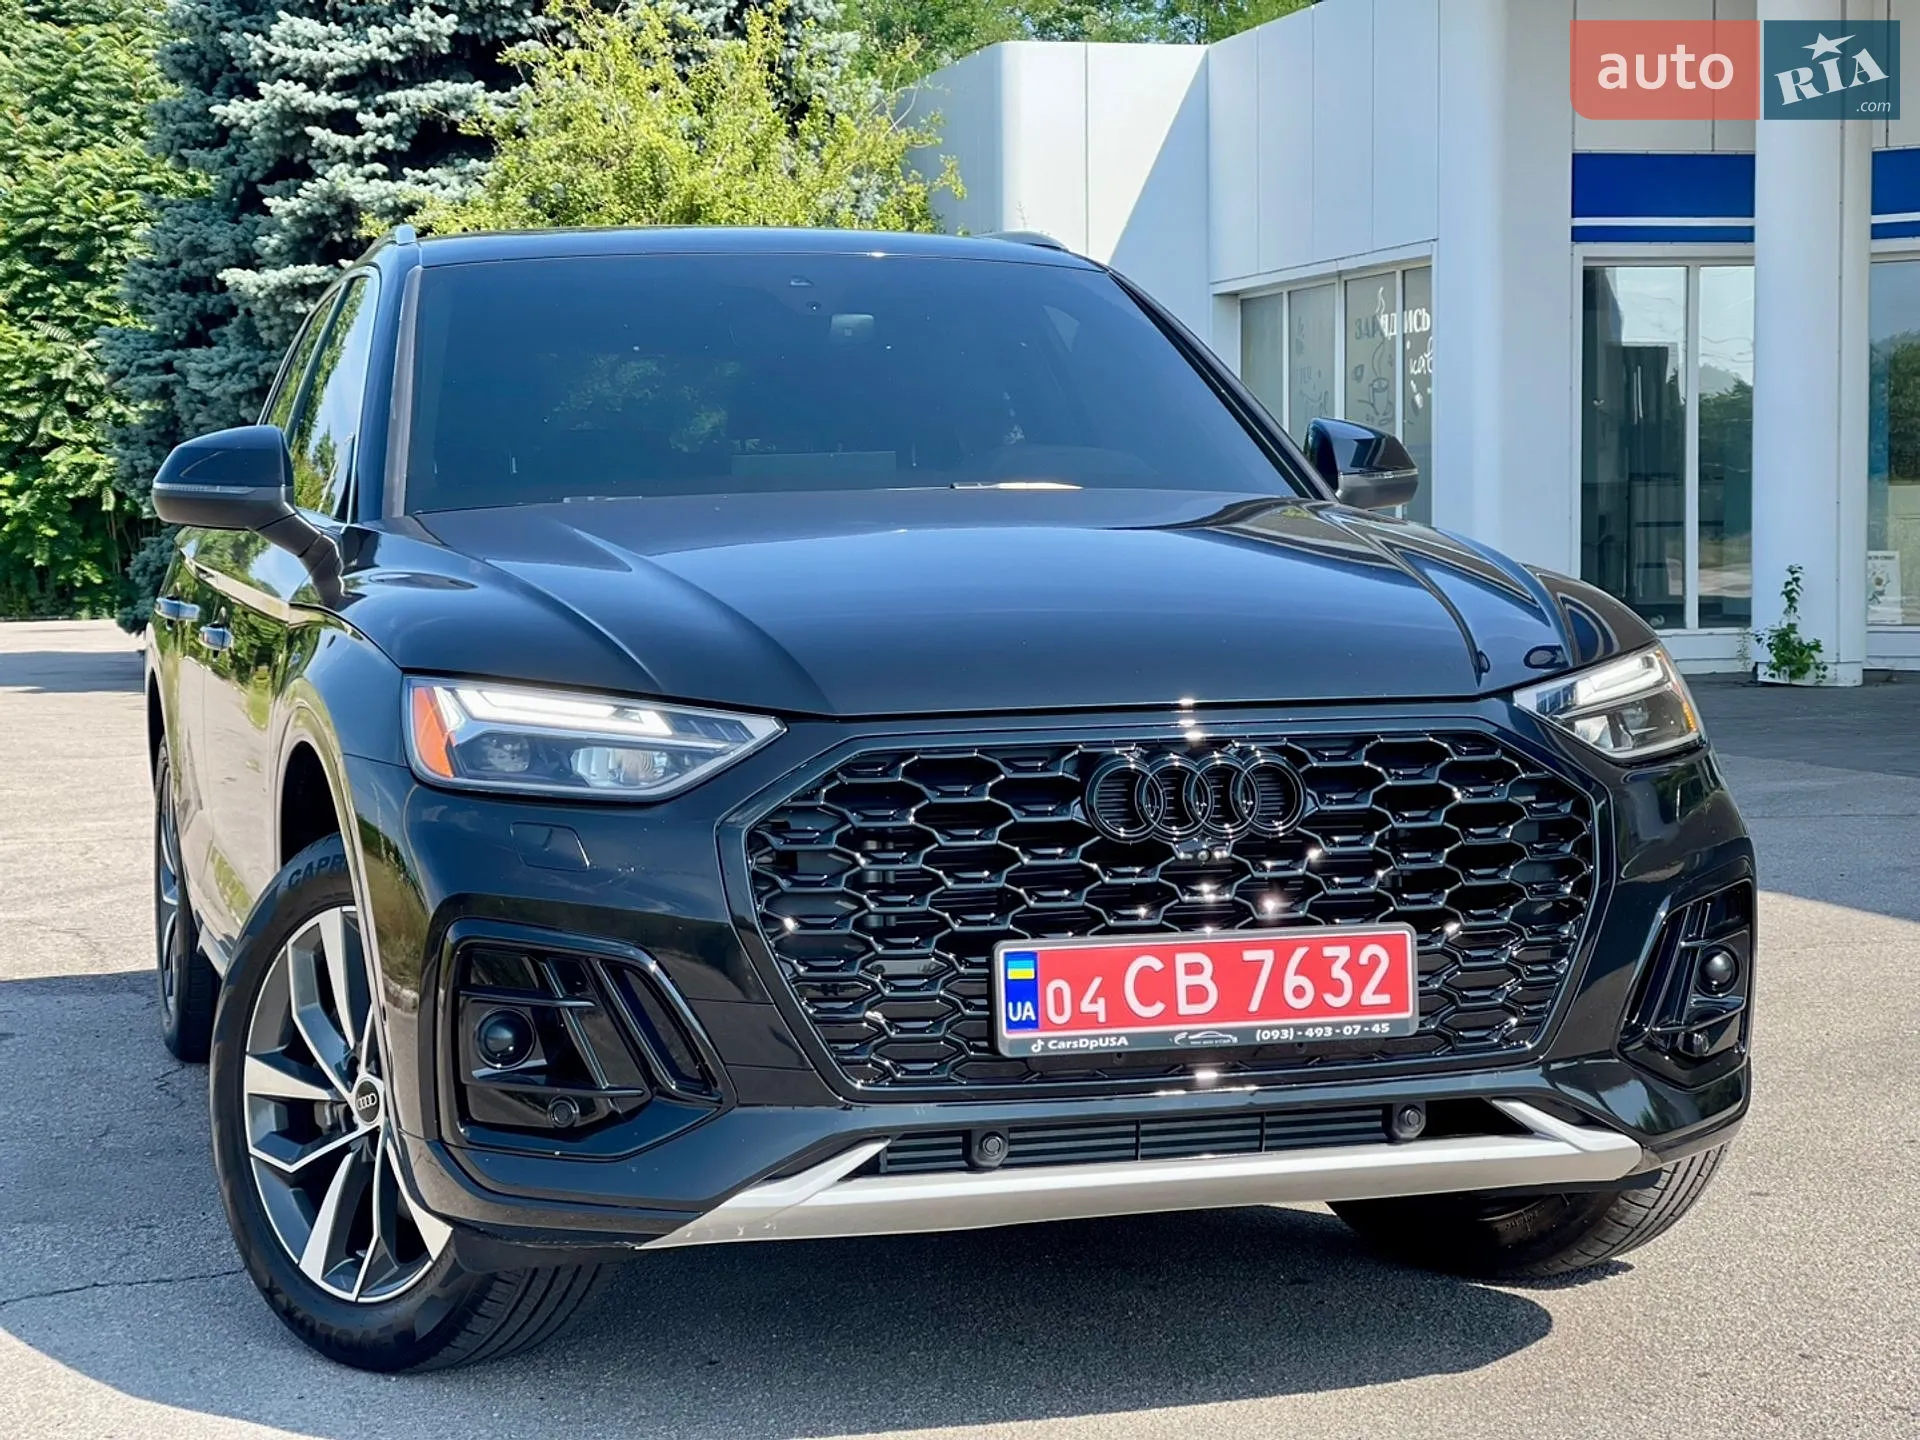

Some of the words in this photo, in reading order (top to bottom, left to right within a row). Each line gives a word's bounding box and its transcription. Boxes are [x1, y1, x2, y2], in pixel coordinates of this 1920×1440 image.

[1045, 976, 1106, 1025] 04
[1123, 952, 1219, 1018] CB
[1241, 943, 1391, 1013] 7632
[1007, 1001, 1037, 1022] UA
